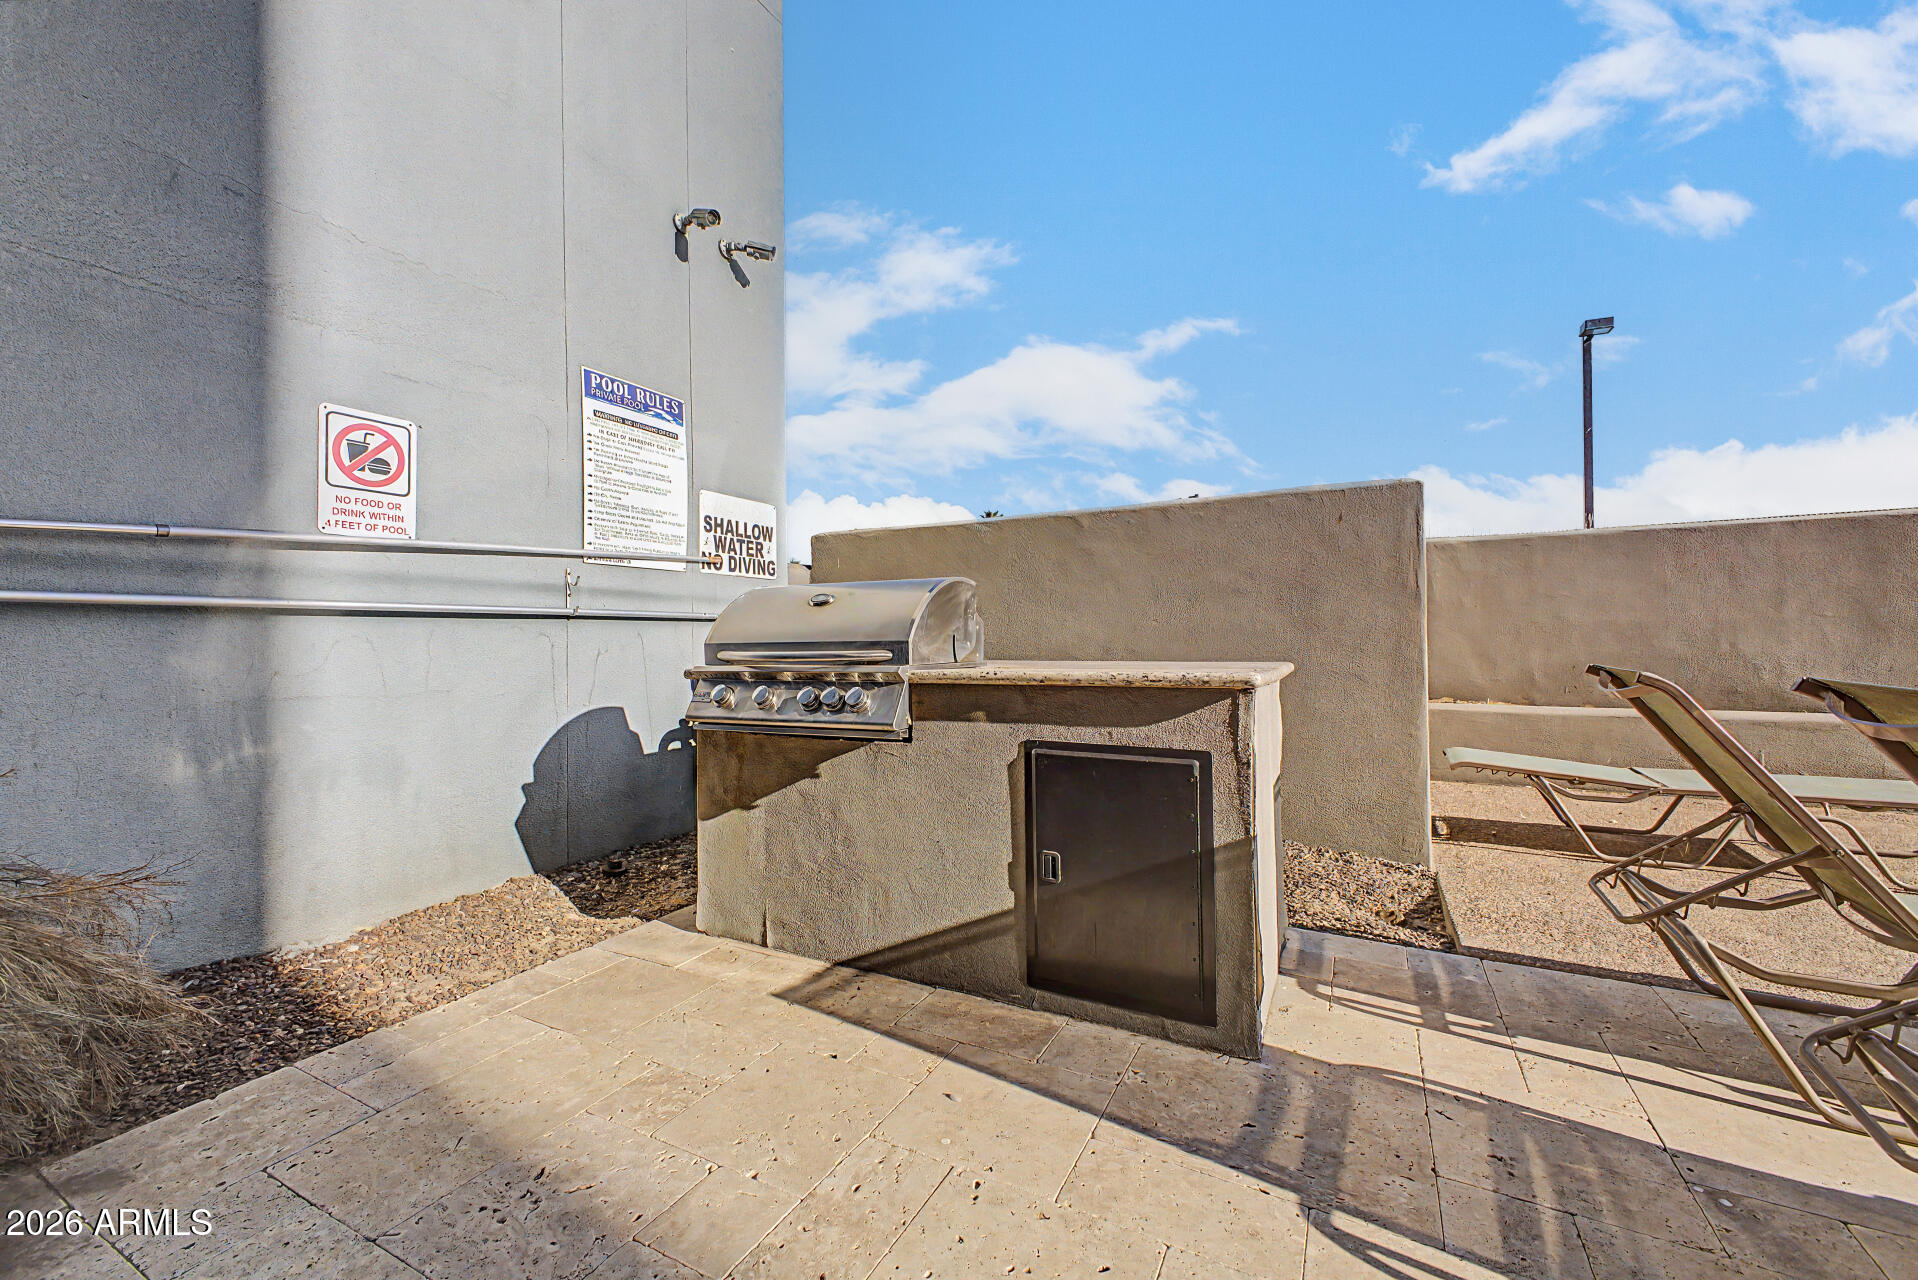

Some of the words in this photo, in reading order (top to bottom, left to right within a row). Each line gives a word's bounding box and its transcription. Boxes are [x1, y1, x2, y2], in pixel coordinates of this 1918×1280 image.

[590, 373, 632, 399] POOL
[635, 387, 679, 414] RULES
[591, 388, 622, 404] PRIVATE
[624, 397, 645, 411] POOL
[332, 507, 365, 519] DRINK
[369, 511, 404, 523] WITHIN
[335, 495, 351, 504] NO
[355, 498, 384, 508] FOOD
[387, 502, 402, 511] OR
[334, 520, 362, 530] FEET
[365, 523, 379, 531] OF
[382, 525, 410, 536] POOL
[703, 514, 774, 543] SHALLOW
[713, 534, 764, 559] WATER
[702, 551, 723, 571] NO
[728, 555, 776, 577] DIVING
